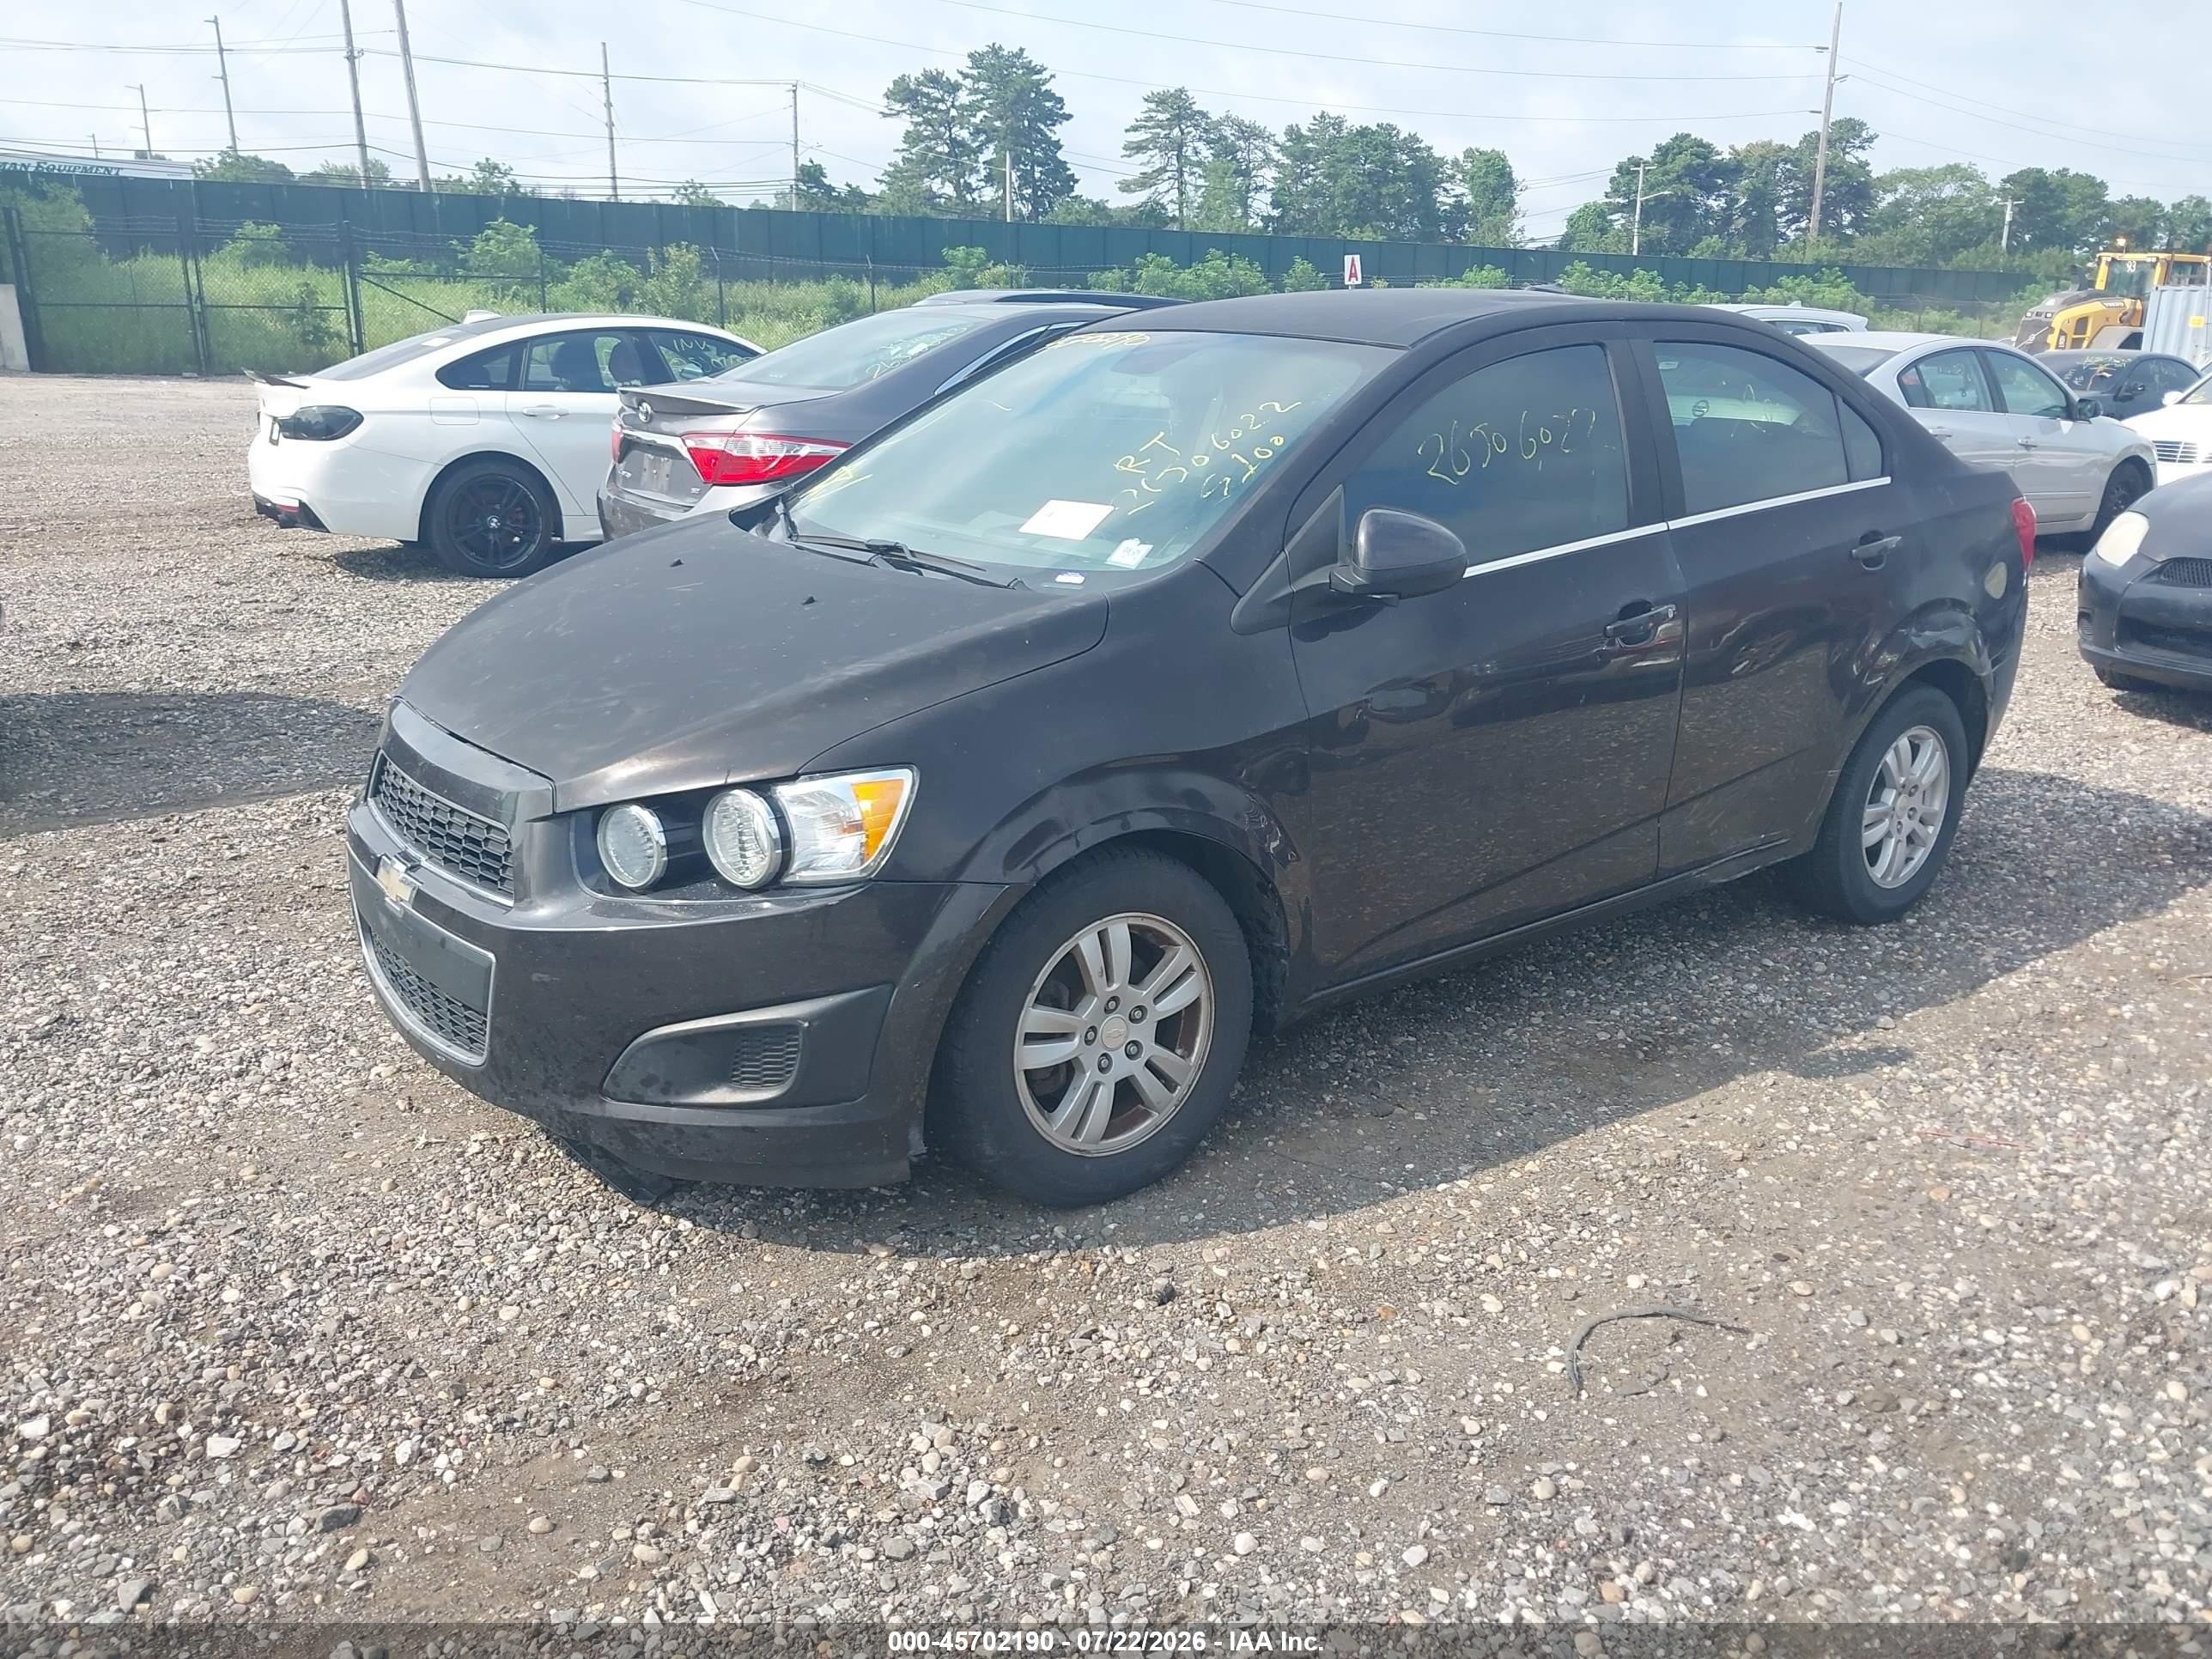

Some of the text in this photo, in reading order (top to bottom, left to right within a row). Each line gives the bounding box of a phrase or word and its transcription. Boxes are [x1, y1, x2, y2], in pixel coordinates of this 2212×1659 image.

[35, 161, 124, 176] EQUIPMENT
[1348, 256, 1358, 282] A
[1113, 432, 1181, 474] RT
